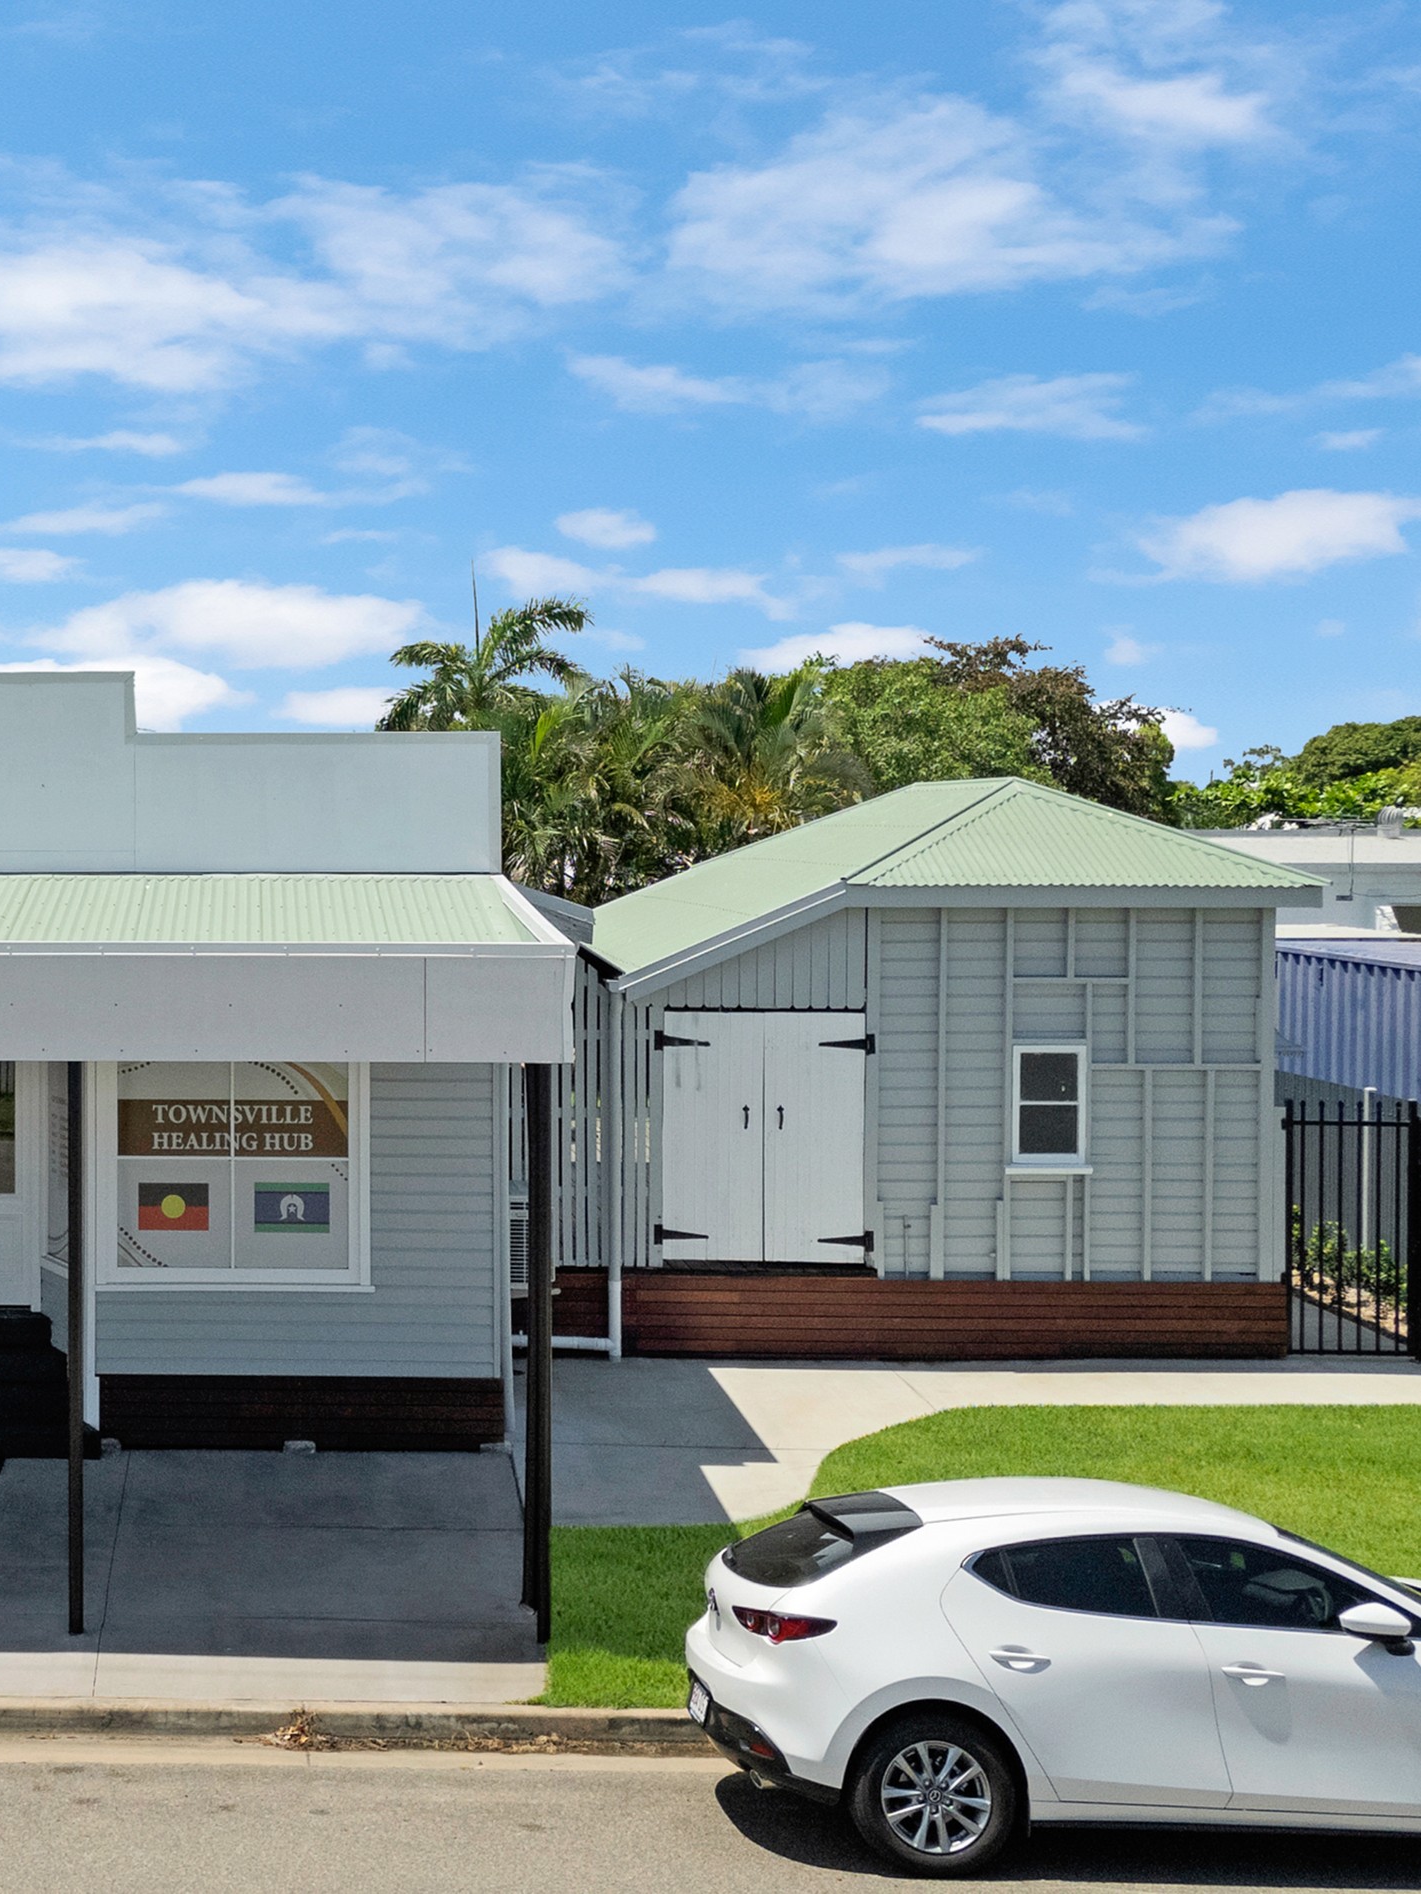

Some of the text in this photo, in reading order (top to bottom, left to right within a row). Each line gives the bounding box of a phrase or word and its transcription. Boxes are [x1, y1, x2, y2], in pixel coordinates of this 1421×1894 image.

[152, 1104, 314, 1124] TOWNSVILLE
[152, 1132, 314, 1151] HEALING HUB
